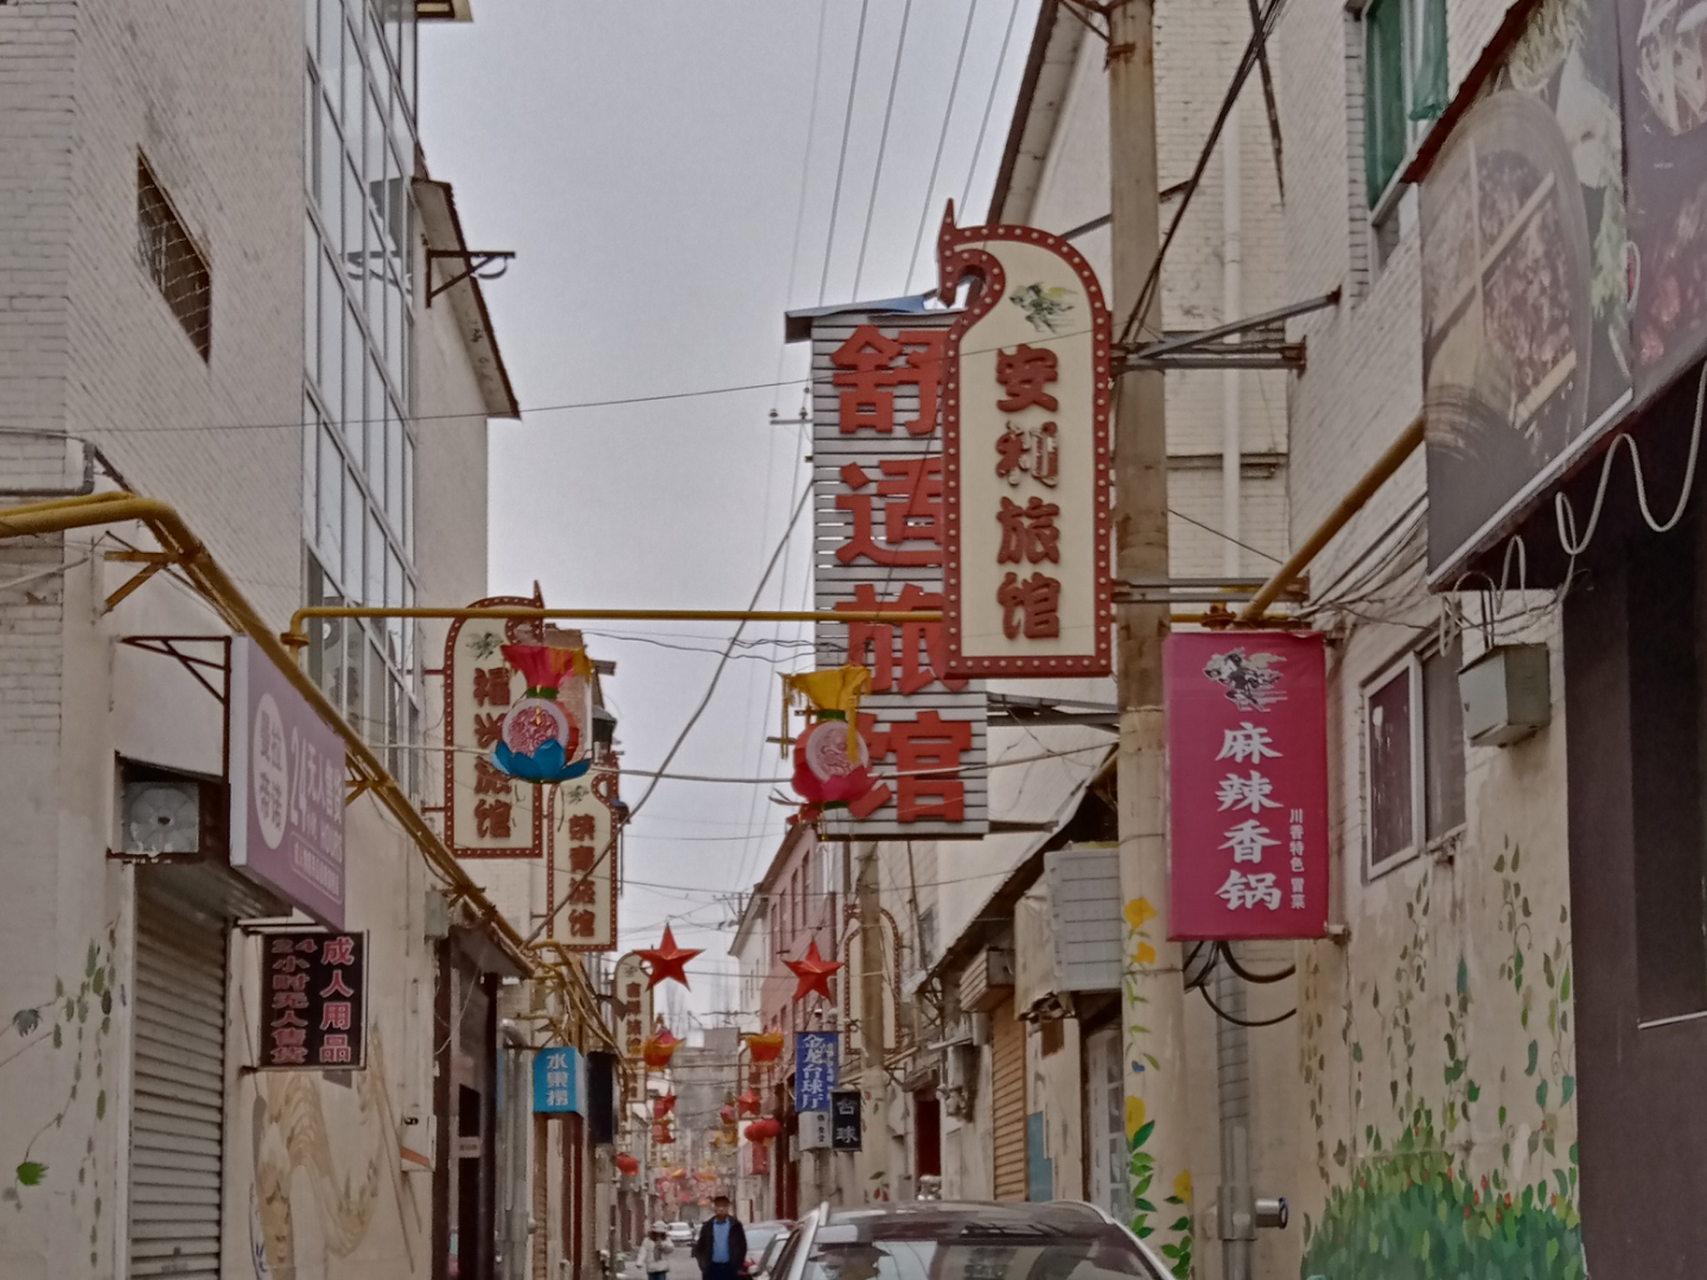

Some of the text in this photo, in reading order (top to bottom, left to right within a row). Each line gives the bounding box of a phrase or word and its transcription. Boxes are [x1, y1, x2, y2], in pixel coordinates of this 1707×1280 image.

[996, 343, 1061, 639] 安利旅馆
[832, 323, 971, 823] 舒适旅馆
[1214, 722, 1284, 911] 麻辣香锅
[270, 938, 317, 1063] 24小时无人售货
[320, 936, 355, 1063] 成人用品
[801, 1034, 825, 1109] 金龙台球厅
[836, 1098, 858, 1144] 台球
